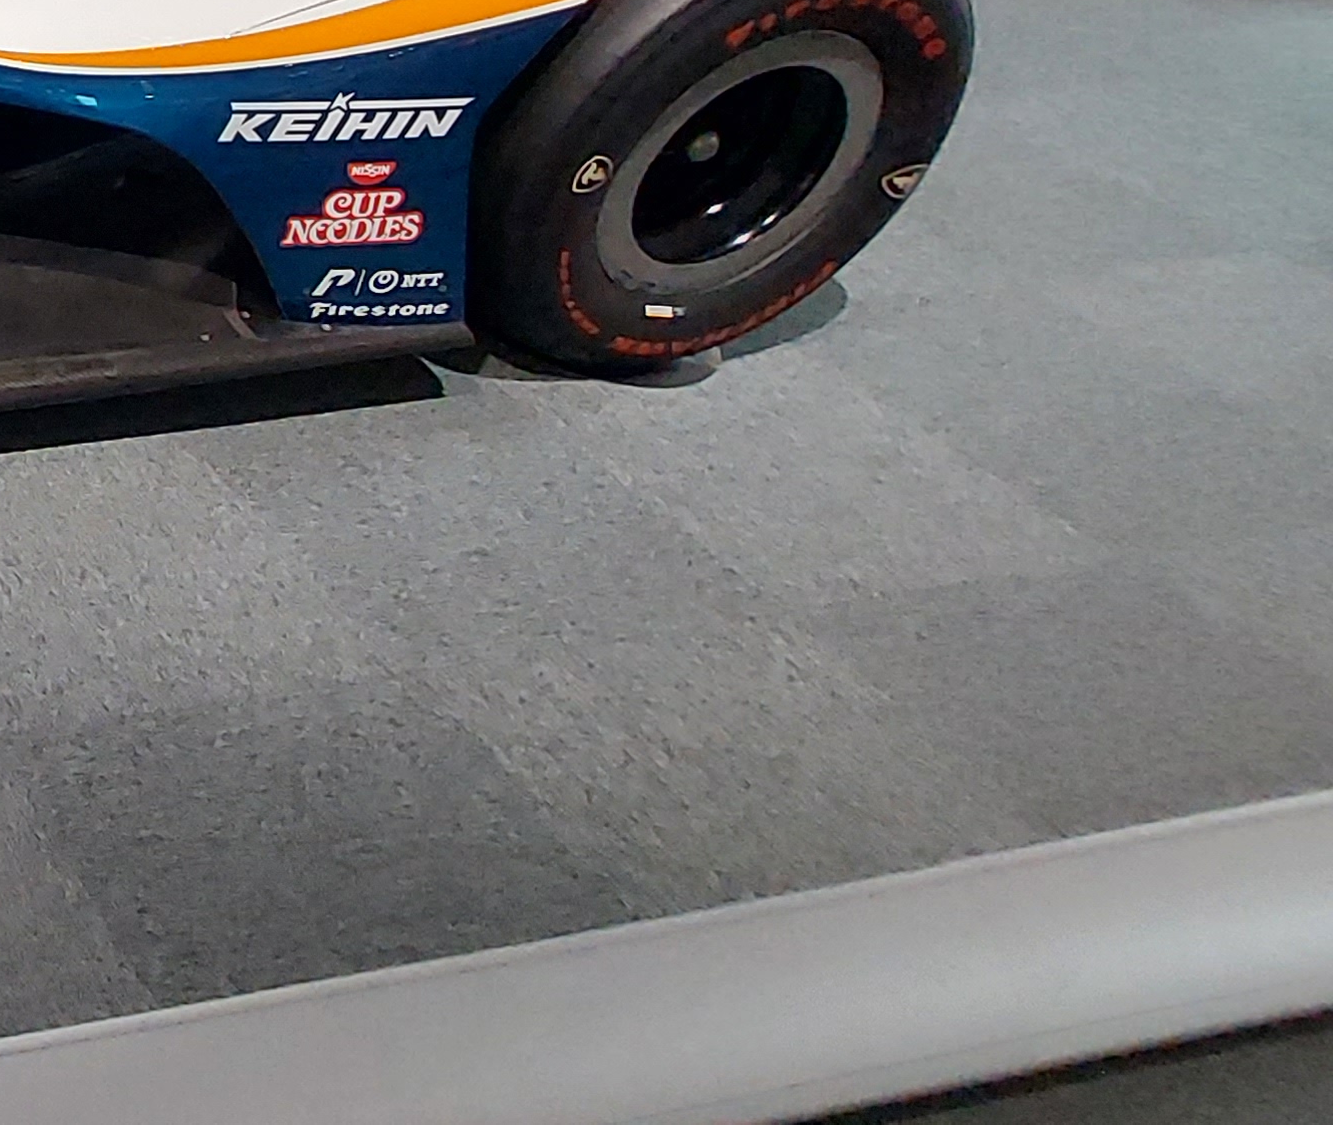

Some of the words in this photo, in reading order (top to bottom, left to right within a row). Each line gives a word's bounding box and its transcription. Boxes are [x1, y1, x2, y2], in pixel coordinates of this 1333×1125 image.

[217, 98, 471, 143] KEIHIN
[351, 162, 391, 177] NISSIN
[325, 190, 403, 217] CUP
[281, 214, 422, 244] NOODLES
[400, 272, 444, 288] NTT
[309, 301, 451, 319] Firestone
